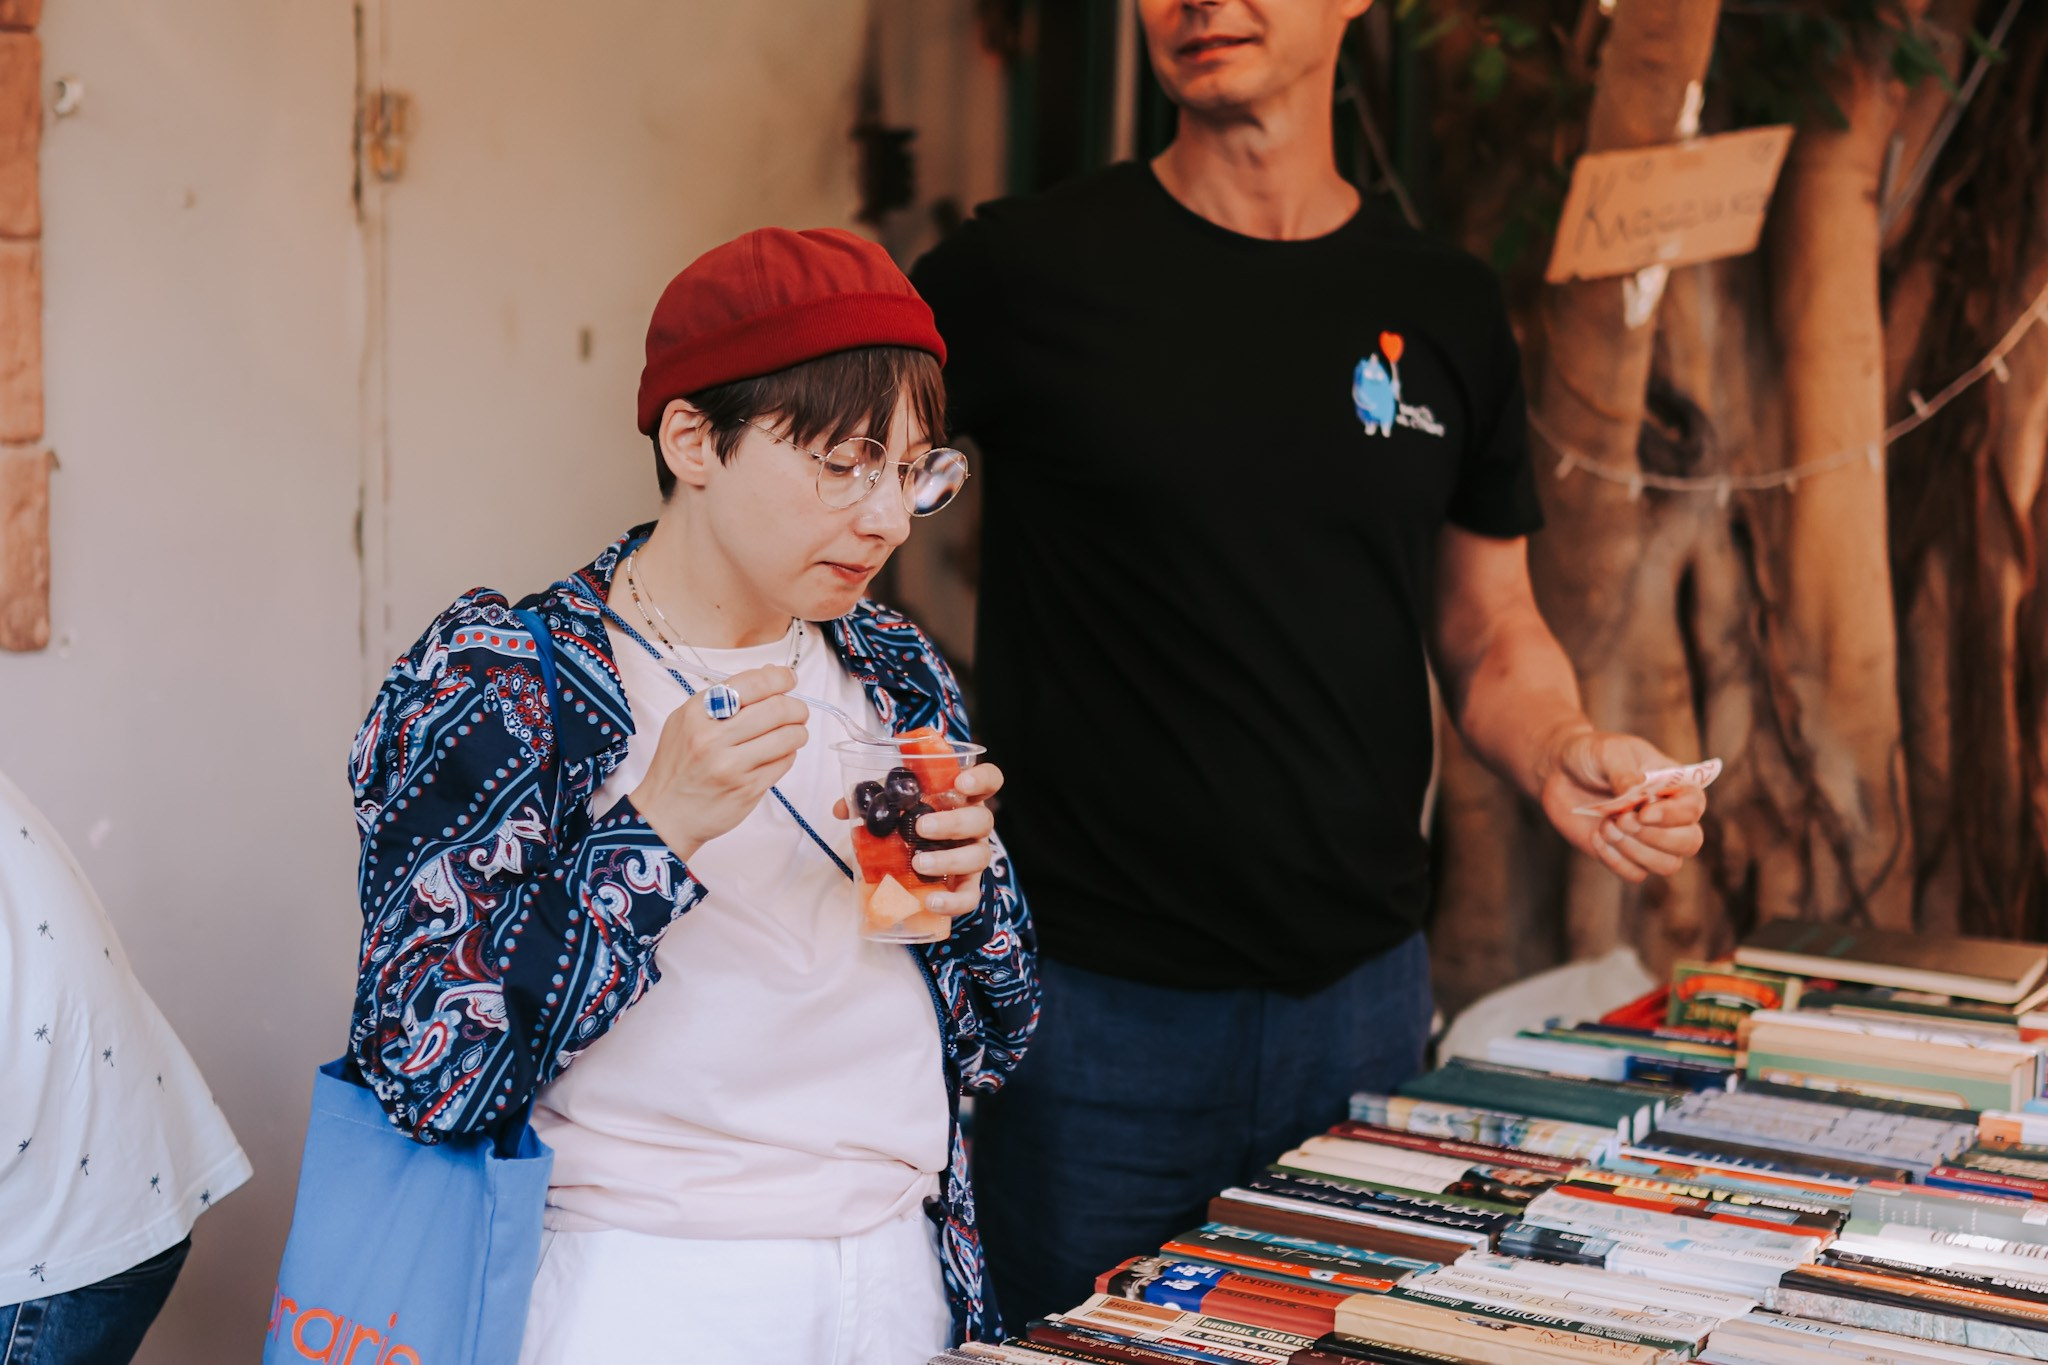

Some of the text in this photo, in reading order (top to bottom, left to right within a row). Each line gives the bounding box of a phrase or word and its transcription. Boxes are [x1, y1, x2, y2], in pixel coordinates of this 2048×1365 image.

[1403, 1289, 1464, 1308] Владимир
[1202, 1320, 1315, 1350] НИКОЛАС СПАРКС,
